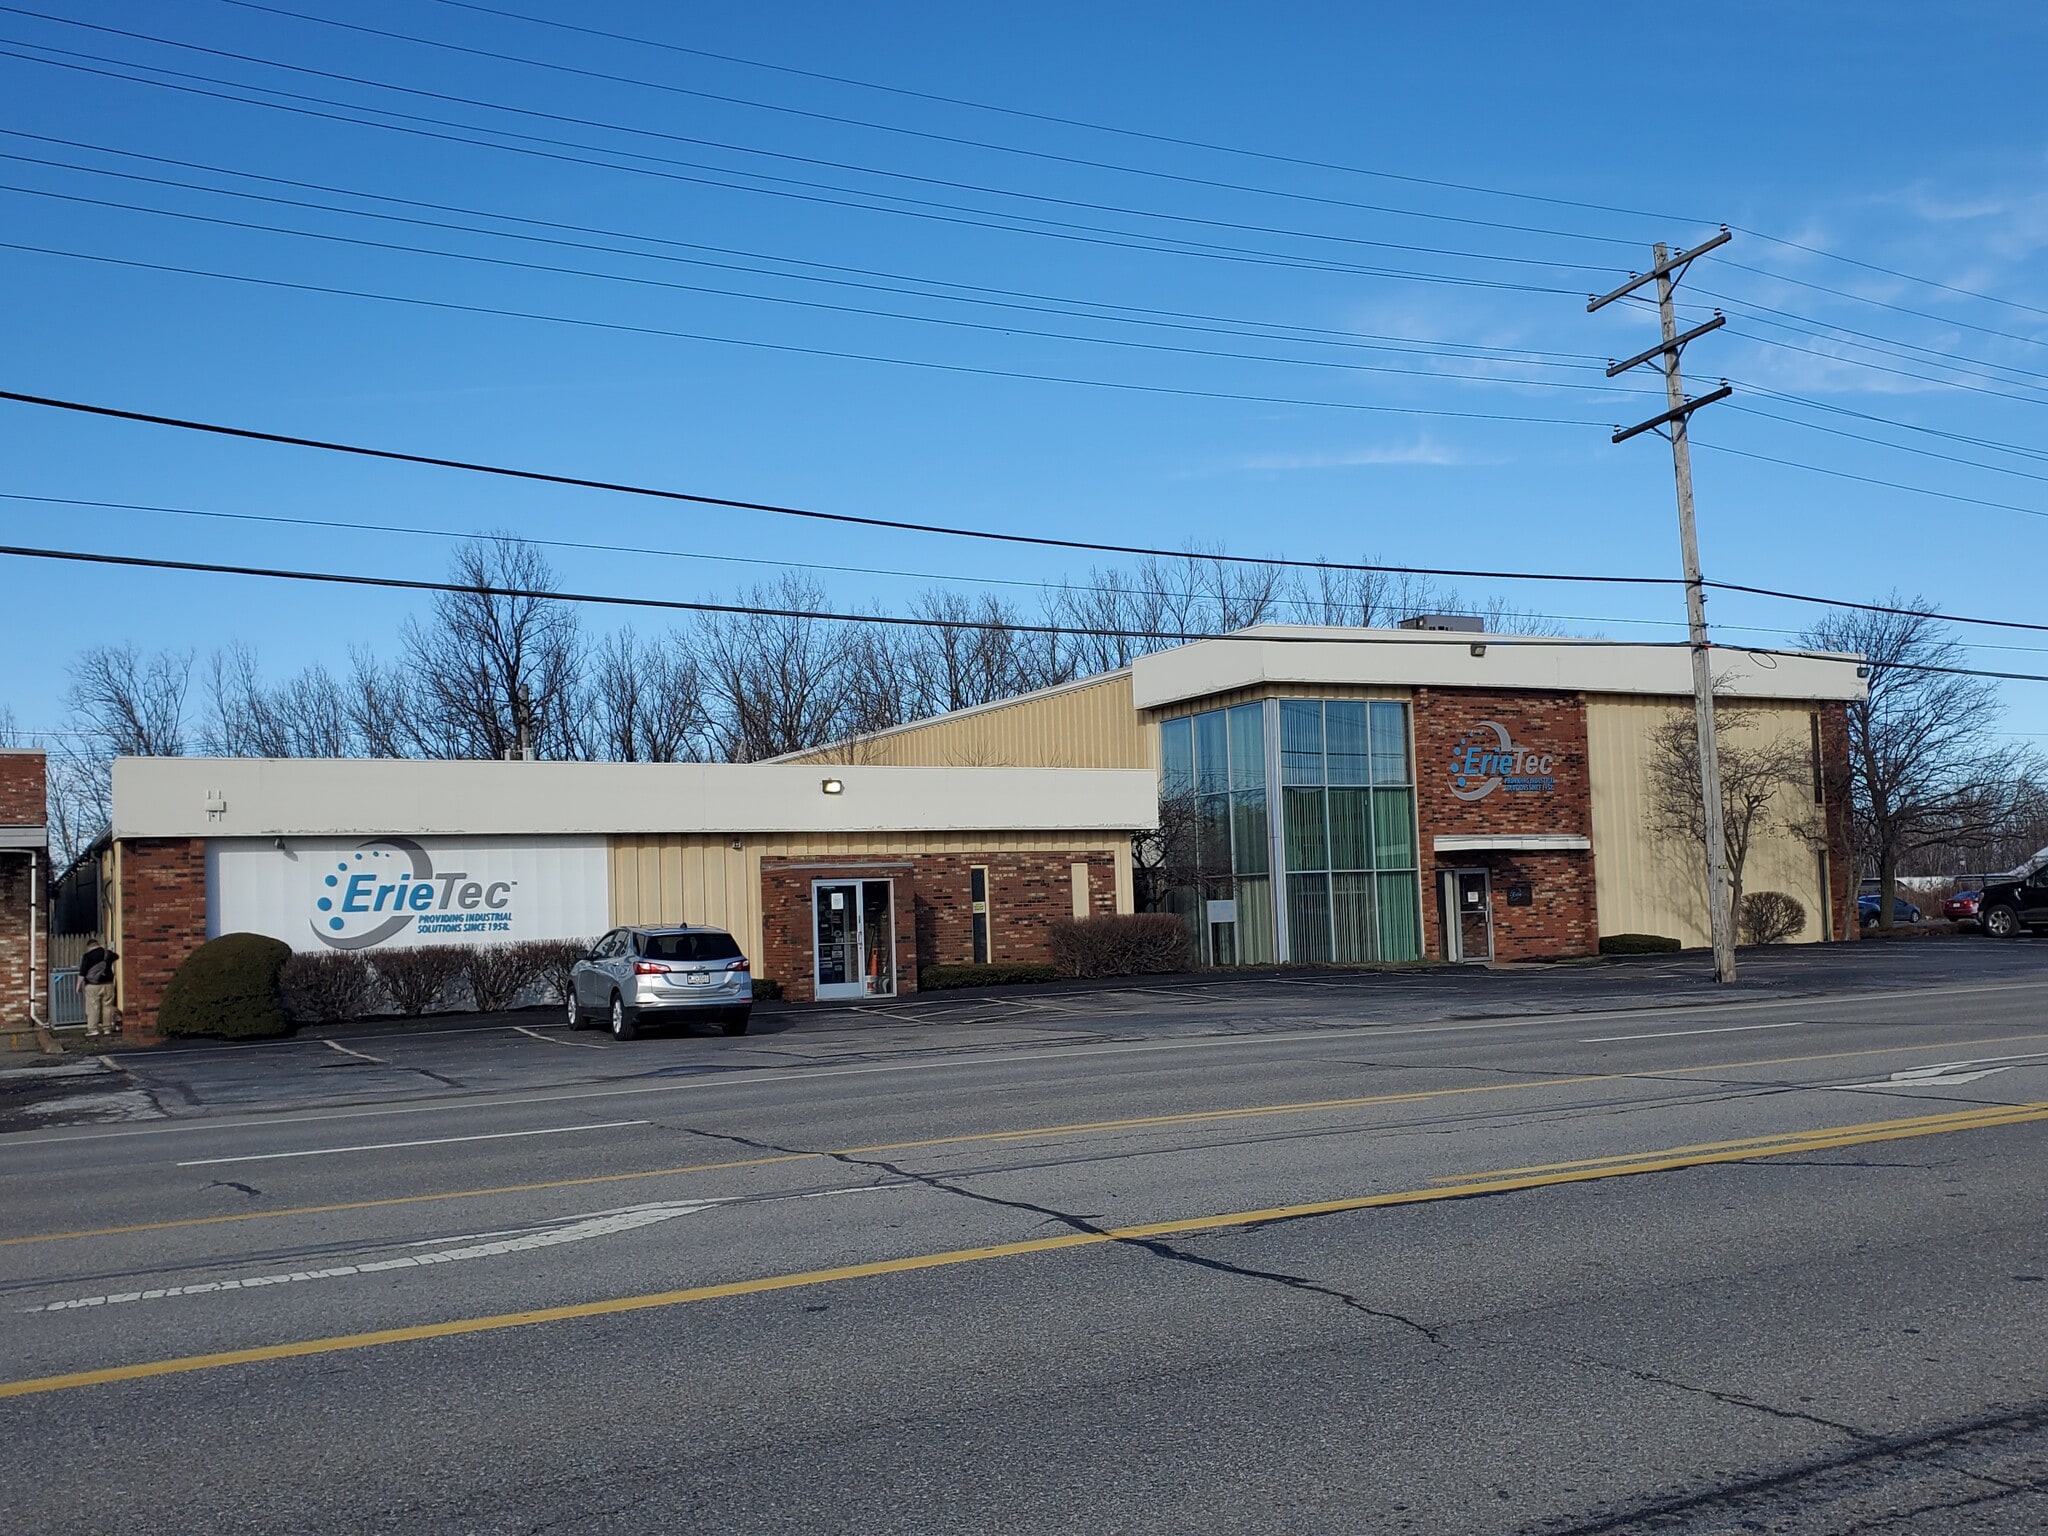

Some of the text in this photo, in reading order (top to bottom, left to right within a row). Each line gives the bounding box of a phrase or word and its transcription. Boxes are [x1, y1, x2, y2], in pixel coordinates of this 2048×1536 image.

[1464, 747, 1553, 775] ErieTec
[342, 873, 511, 911] ErieTec
[417, 923, 462, 933] SOLUTIONS
[463, 922, 486, 932] SINCE
[419, 912, 512, 924] PROVIDING INDUSTRIAL
